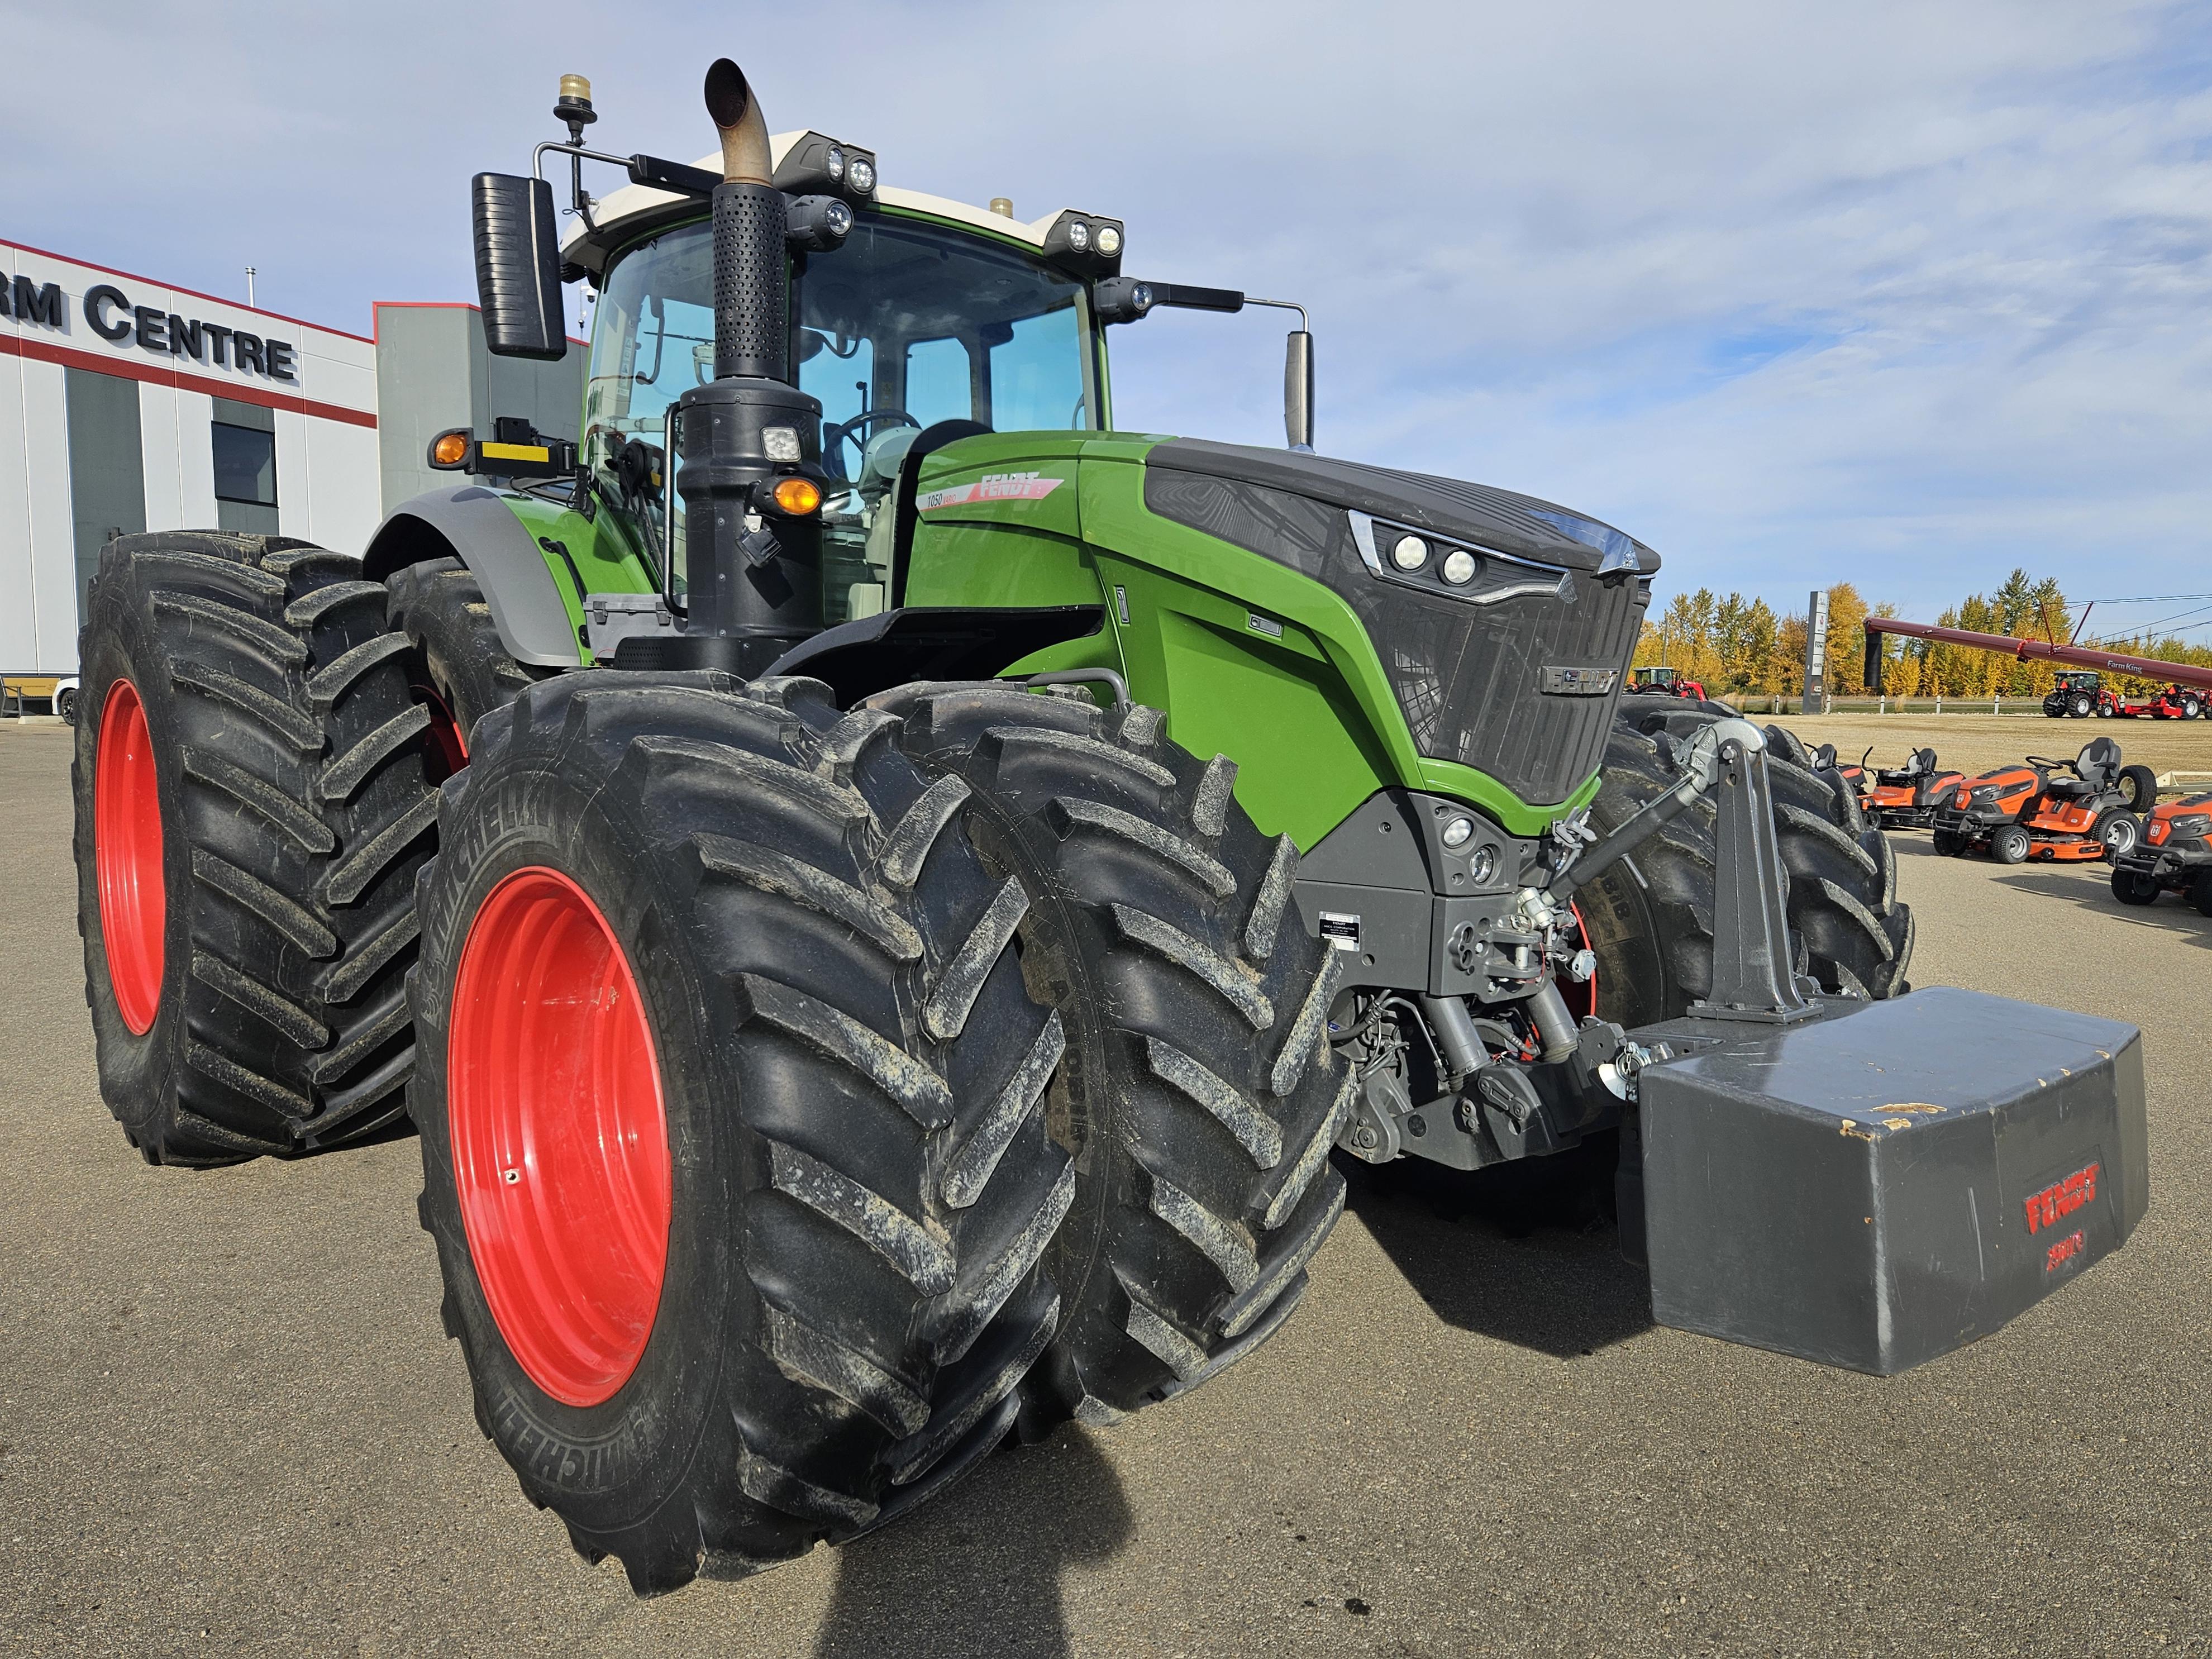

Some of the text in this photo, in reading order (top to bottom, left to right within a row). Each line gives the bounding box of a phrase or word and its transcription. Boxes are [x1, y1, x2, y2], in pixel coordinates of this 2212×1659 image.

[84, 284, 294, 379] CENTRE
[980, 471, 1040, 497] FENDT
[928, 493, 956, 508] 1050 VARIO
[2107, 660, 2143, 674] Farm King
[2024, 1161, 2100, 1235] FENDT
